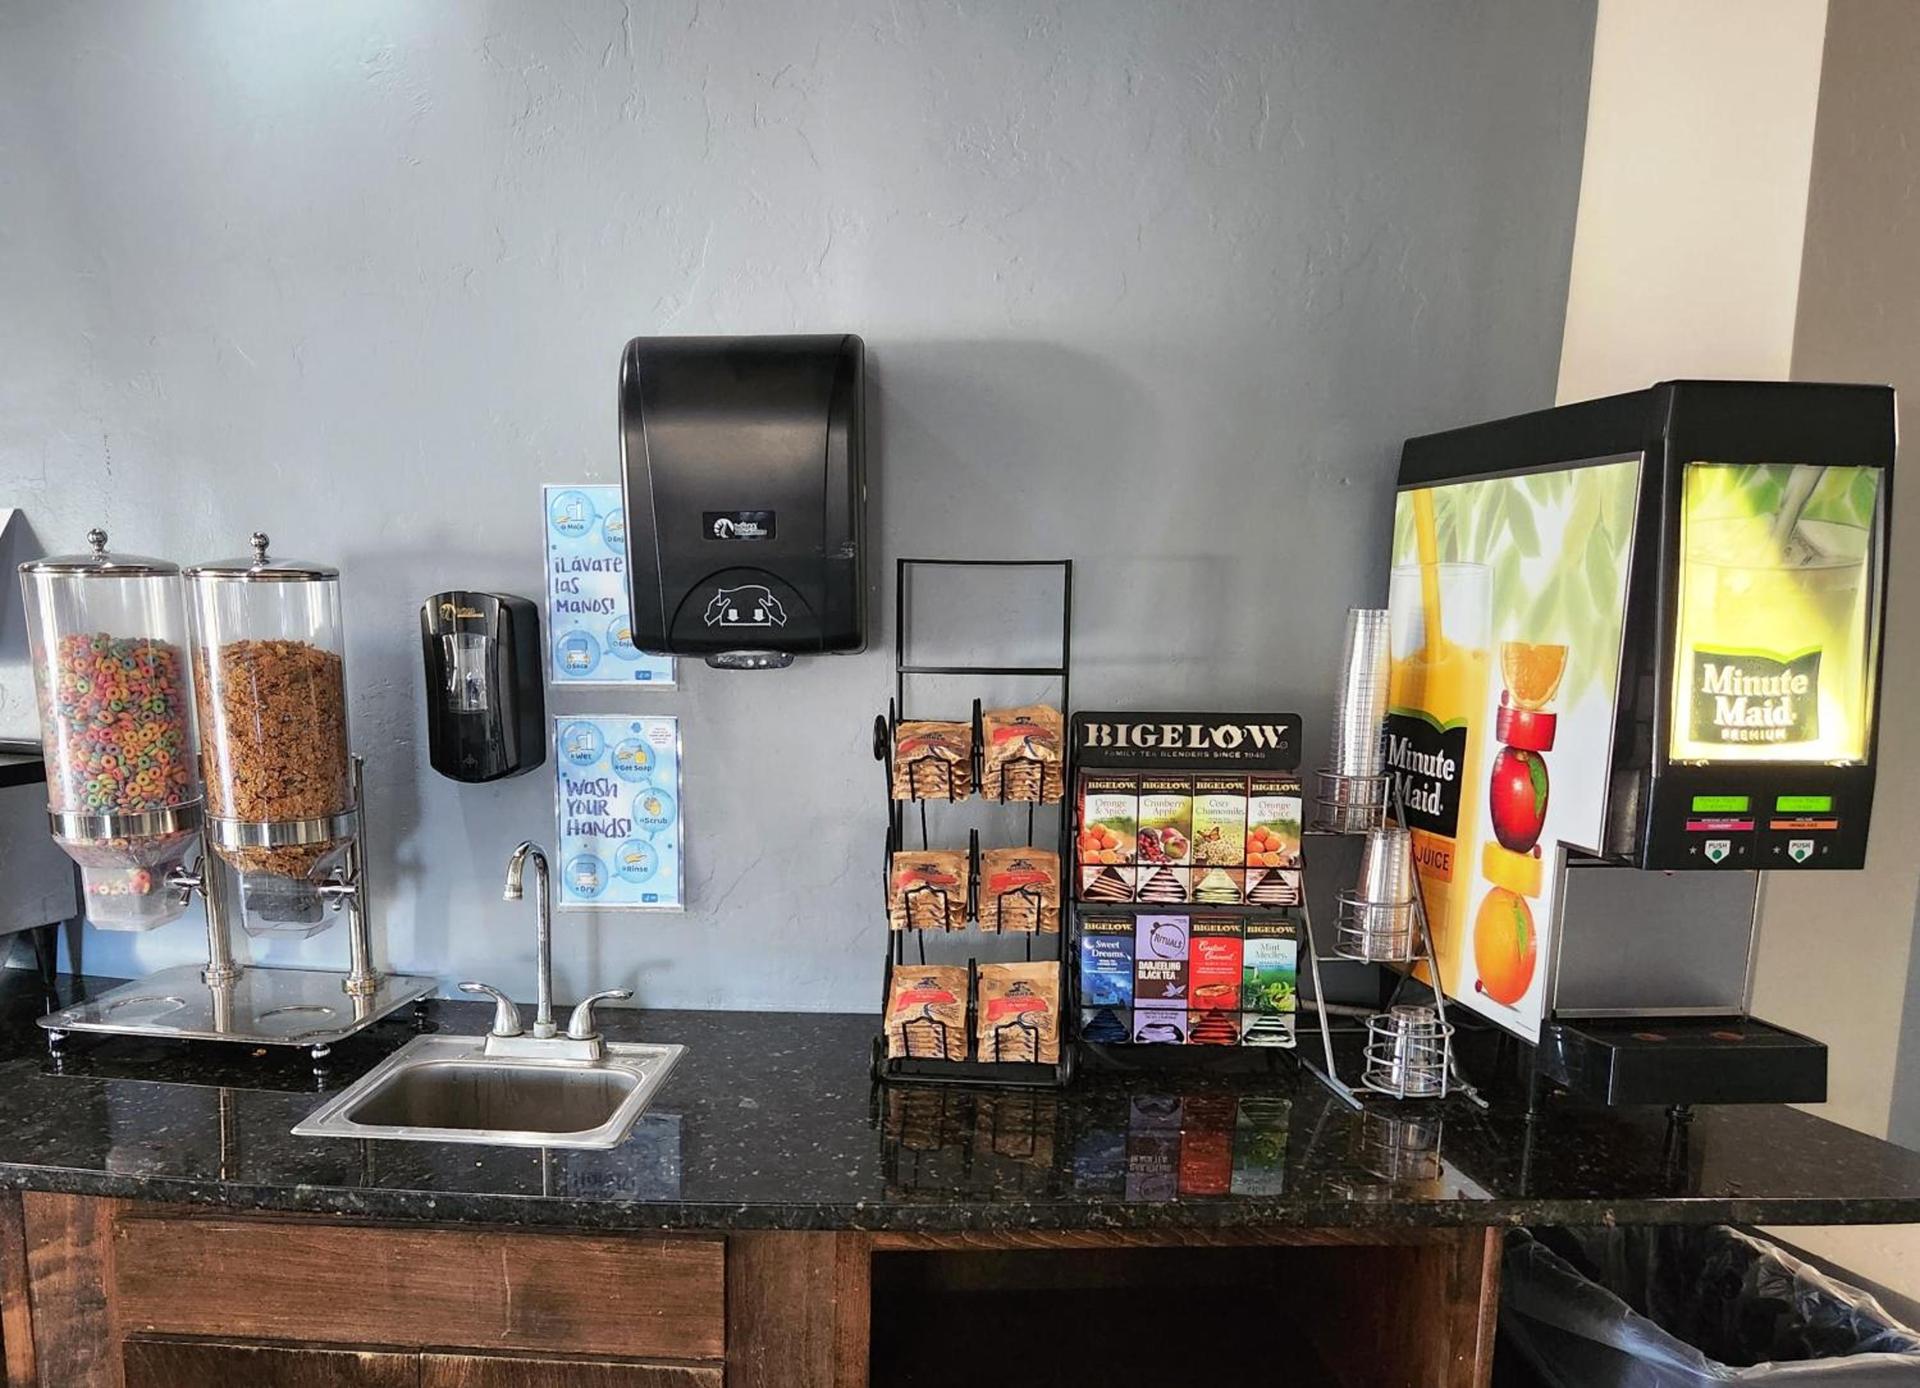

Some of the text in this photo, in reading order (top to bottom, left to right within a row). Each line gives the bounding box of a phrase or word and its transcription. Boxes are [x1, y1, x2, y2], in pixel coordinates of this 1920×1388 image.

[1701, 663, 1809, 696] Minute
[1713, 695, 1797, 726] Maid
[1083, 723, 1289, 749] BIGELOW
[1720, 728, 1787, 741] PREMIUM
[1213, 751, 1241, 759] SINCE
[1387, 734, 1456, 781] Minute
[1088, 781, 1136, 789] BIGELOW
[1142, 781, 1191, 789] BIGELOW
[1196, 782, 1245, 790] BIGELOW
[1251, 783, 1301, 791] BIGELOW
[1392, 771, 1443, 816] Maid
[644, 817, 668, 825] Scrub
[1416, 848, 1449, 871] JUICE
[626, 865, 648, 873] Rinse
[580, 885, 595, 894] Dry
[1084, 922, 1133, 931] BIGELOW
[1193, 924, 1242, 932] BIGELOW
[1247, 926, 1296, 934] BIGELOW
[1096, 940, 1120, 949] Sweet
[1138, 961, 1181, 971] DARJEELING
[1138, 970, 1176, 980] BLACK TEA
